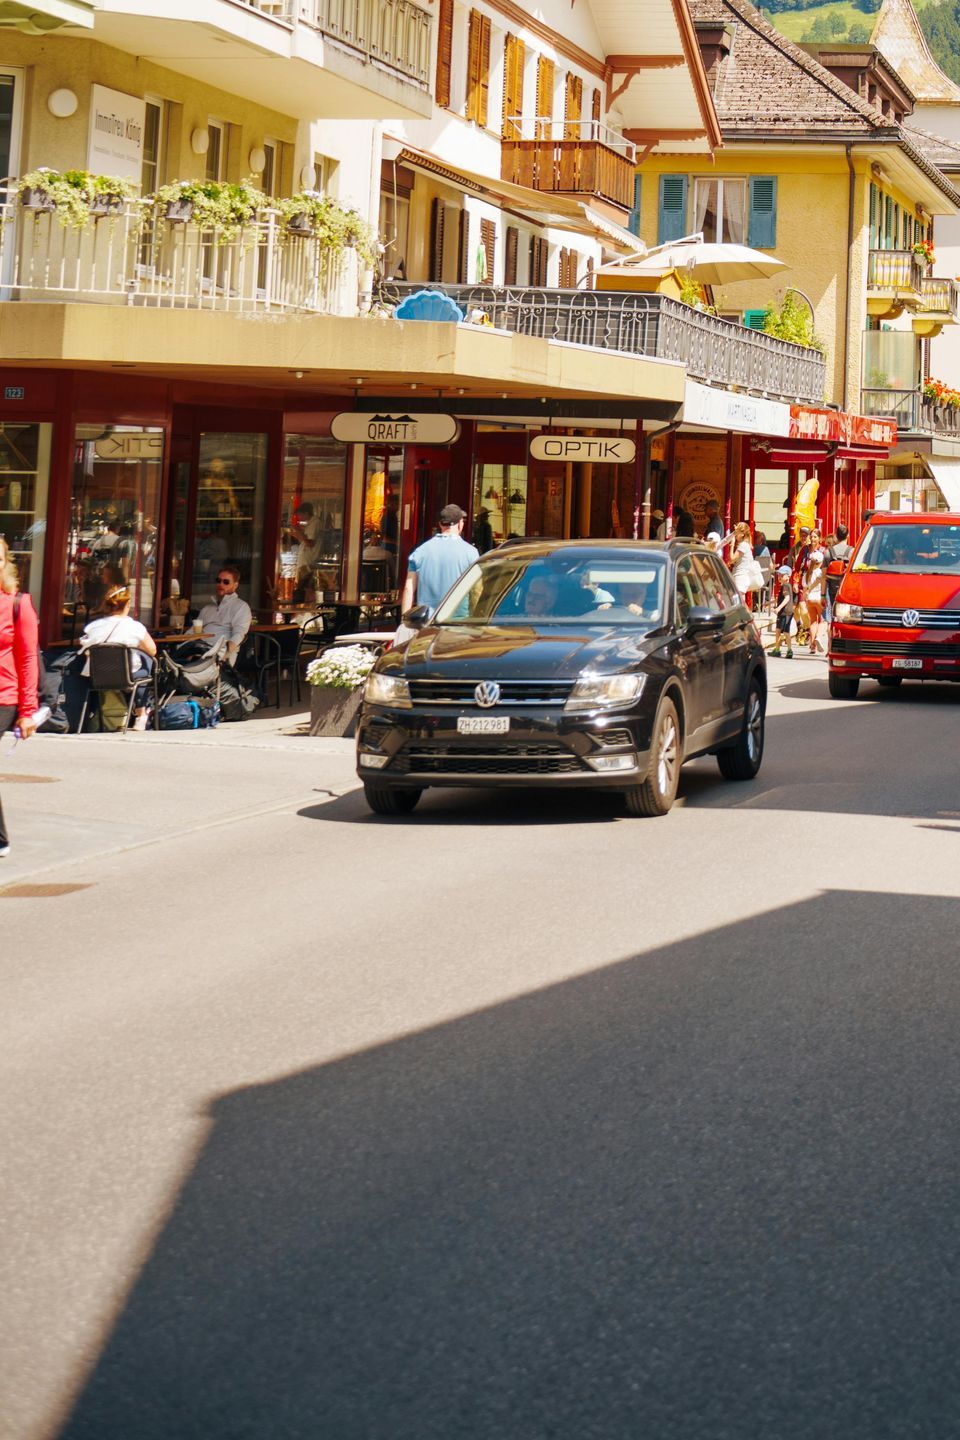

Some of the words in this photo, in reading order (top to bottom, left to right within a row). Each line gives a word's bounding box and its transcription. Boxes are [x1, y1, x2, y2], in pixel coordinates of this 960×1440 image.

[7, 389, 22, 398] 123
[368, 423, 409, 440] QRAFT
[544, 440, 621, 458] OPTIK
